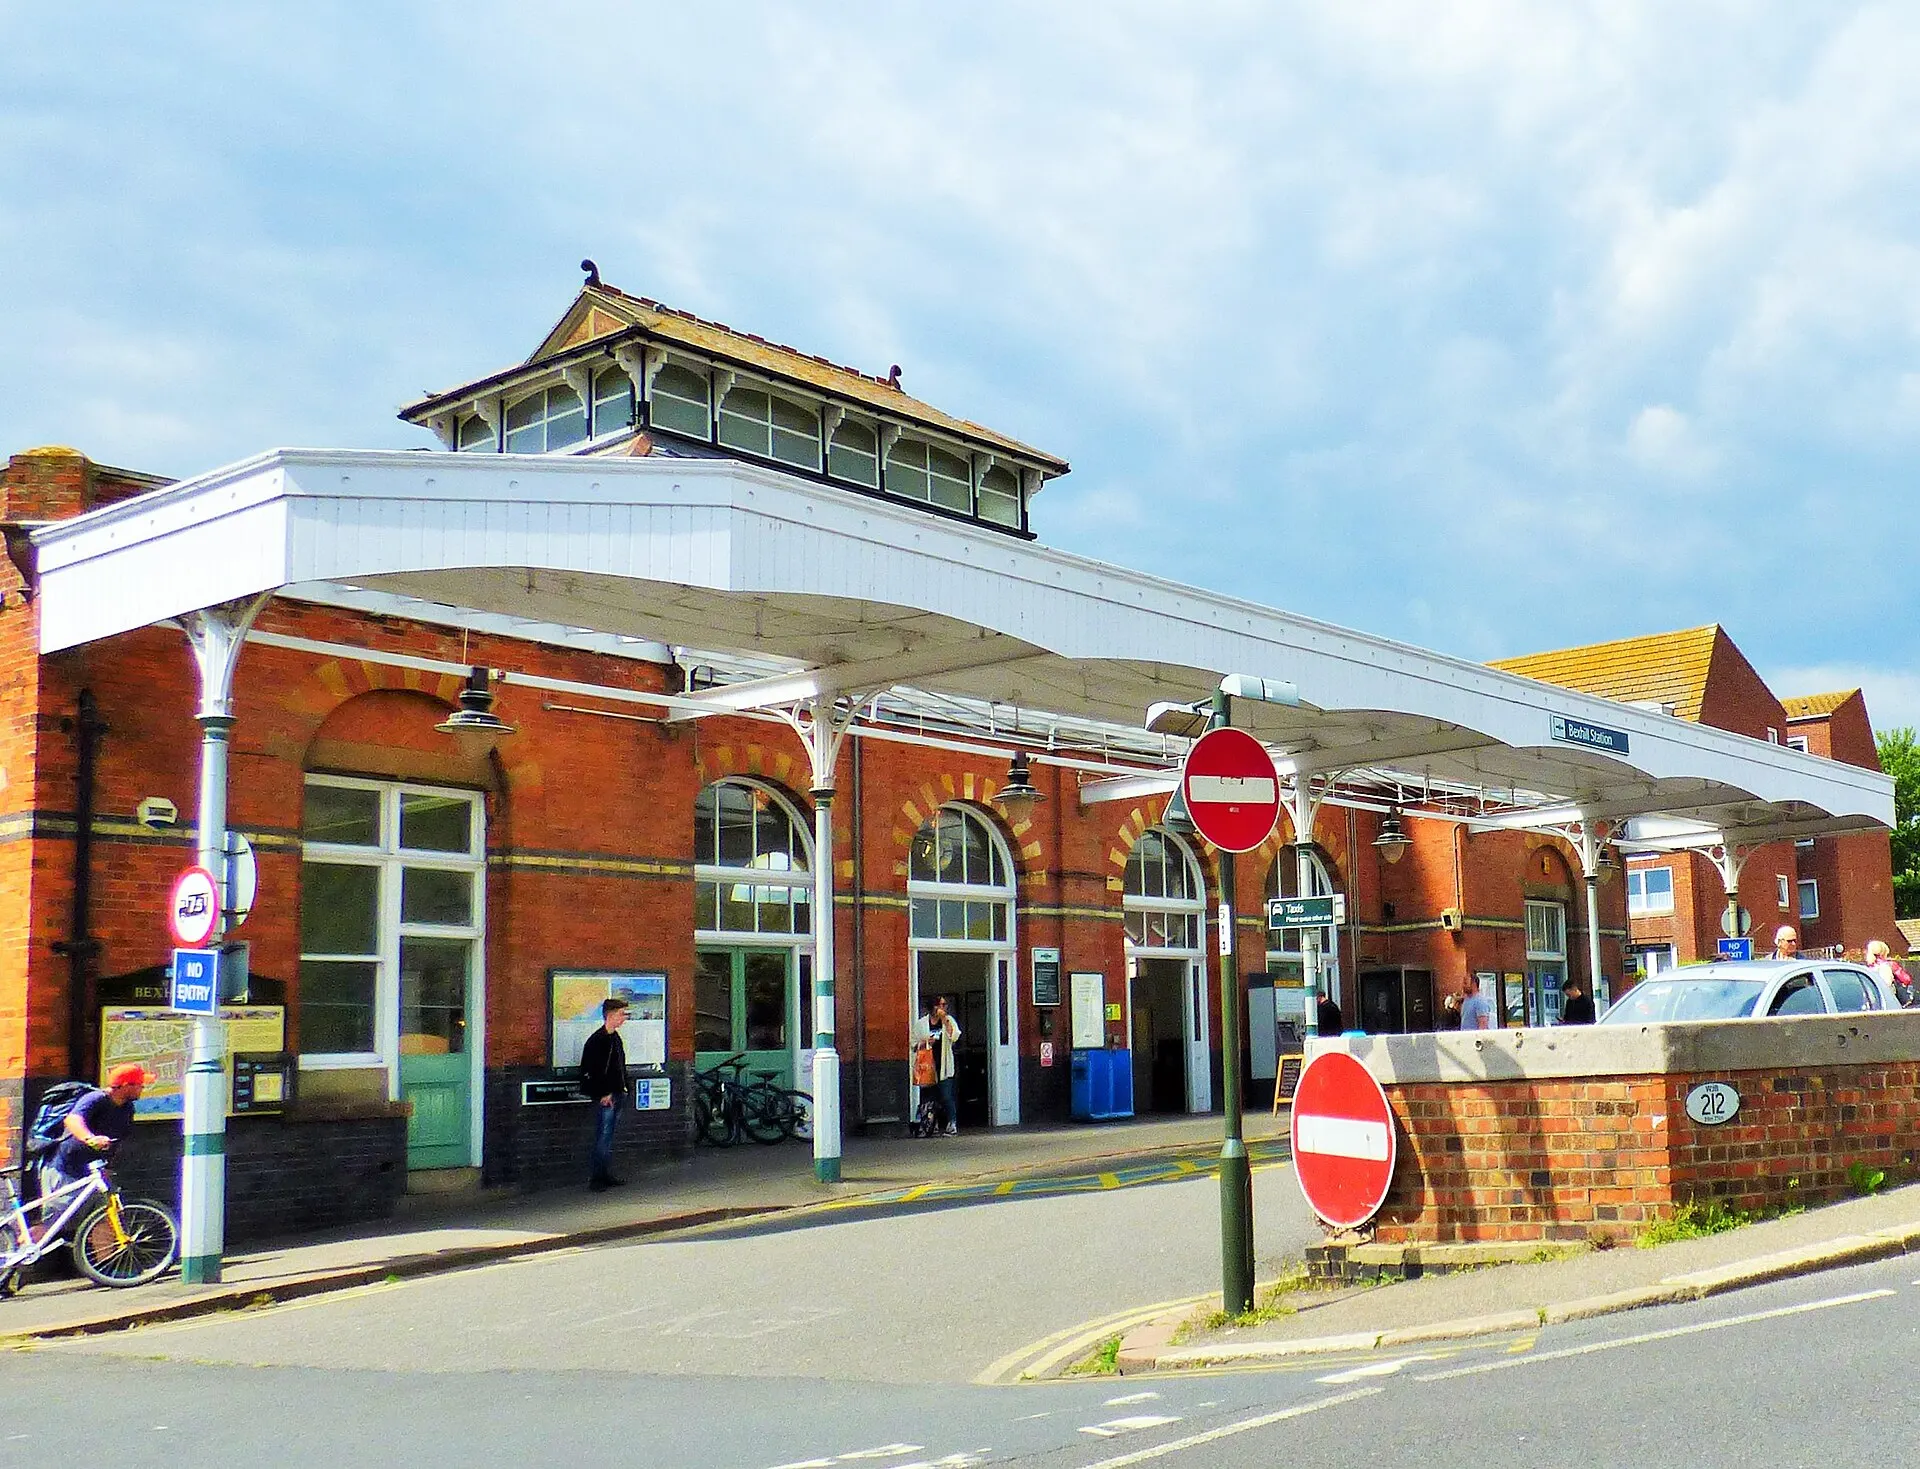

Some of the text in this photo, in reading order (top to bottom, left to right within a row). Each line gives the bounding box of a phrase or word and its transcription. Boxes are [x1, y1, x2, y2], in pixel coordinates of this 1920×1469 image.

[1568, 723, 1613, 746] Bexhill Station
[1285, 903, 1304, 914] Taxis
[1728, 942, 1741, 950] NO
[186, 961, 203, 978] NO
[177, 984, 210, 1002] ENTRY
[1700, 1092, 1725, 1115] 212
